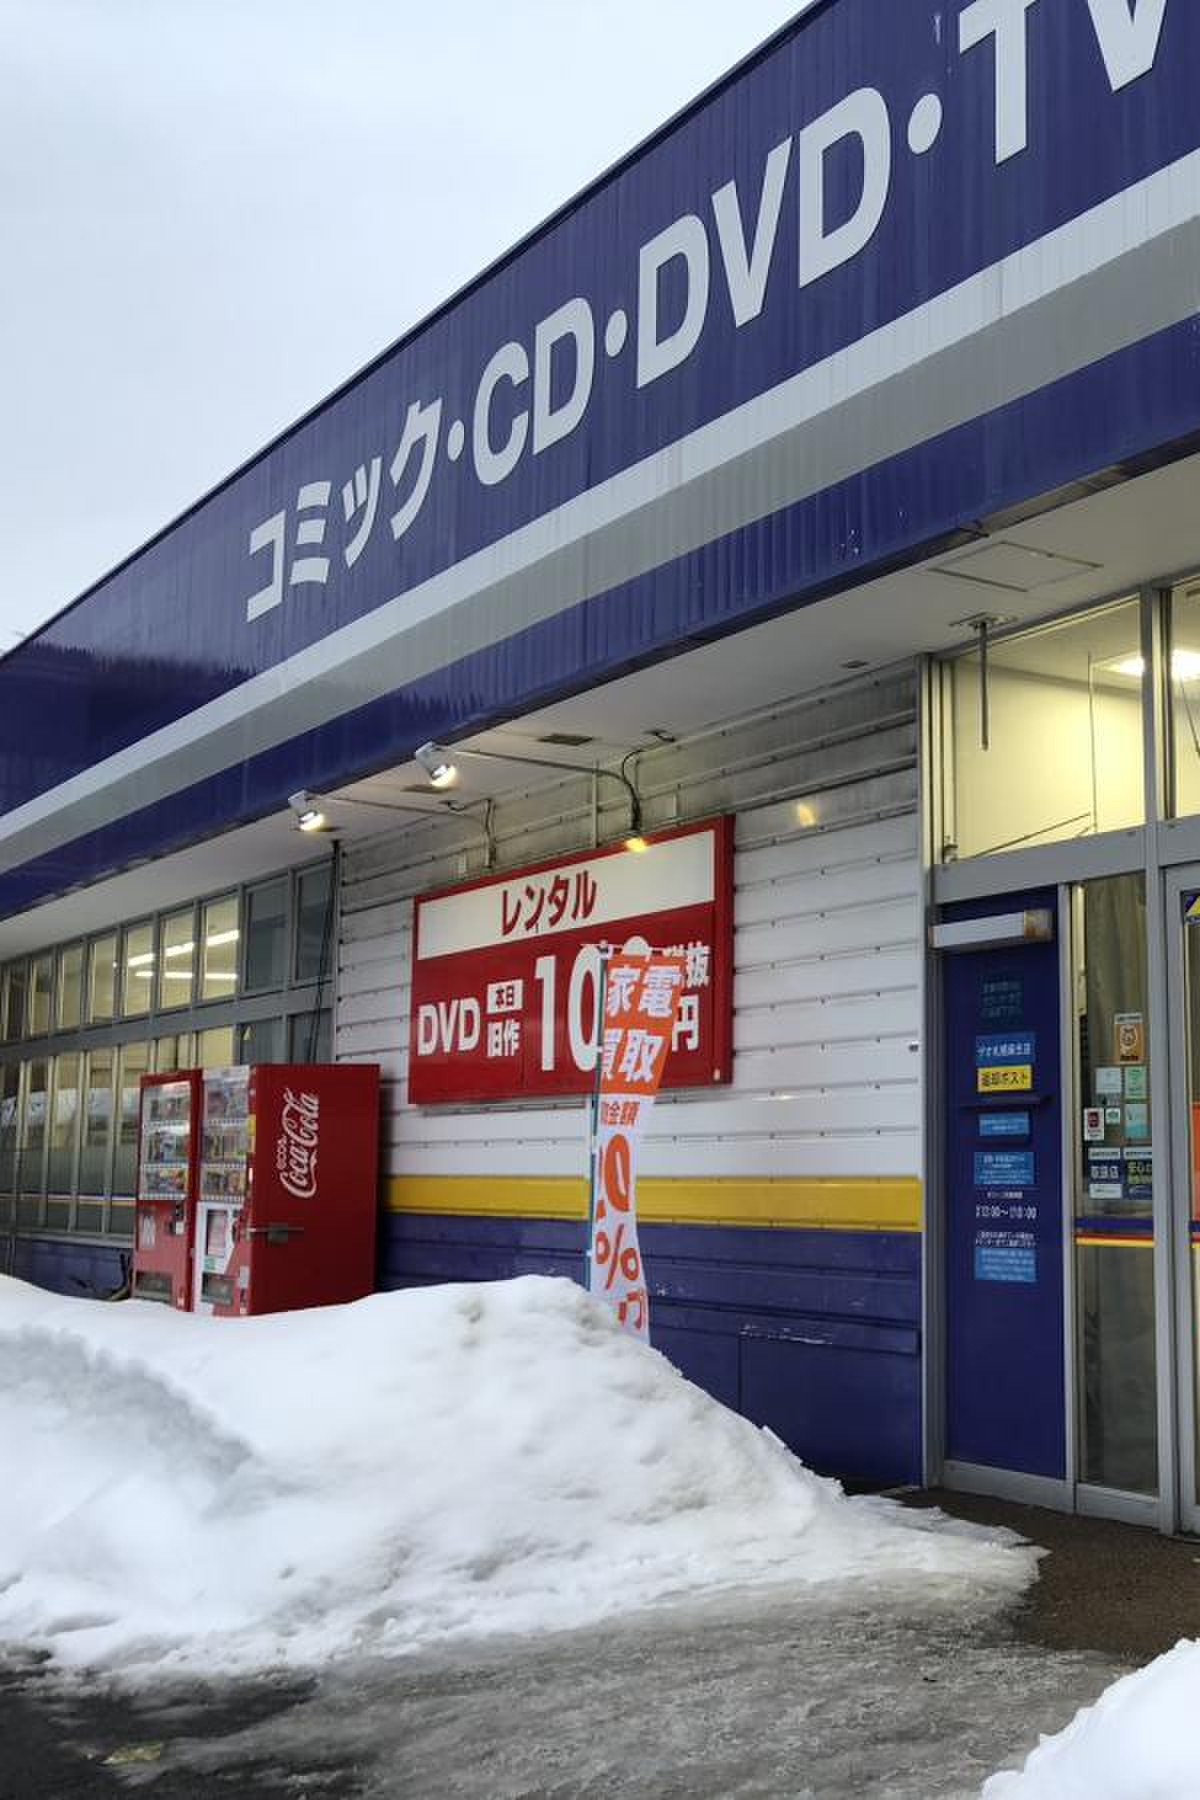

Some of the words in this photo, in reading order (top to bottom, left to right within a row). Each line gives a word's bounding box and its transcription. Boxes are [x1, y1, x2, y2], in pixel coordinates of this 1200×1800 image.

[501, 870, 596, 936] レンタル
[606, 964, 683, 1018] 家電
[416, 997, 481, 1056] DVD
[671, 994, 700, 1051] 円
